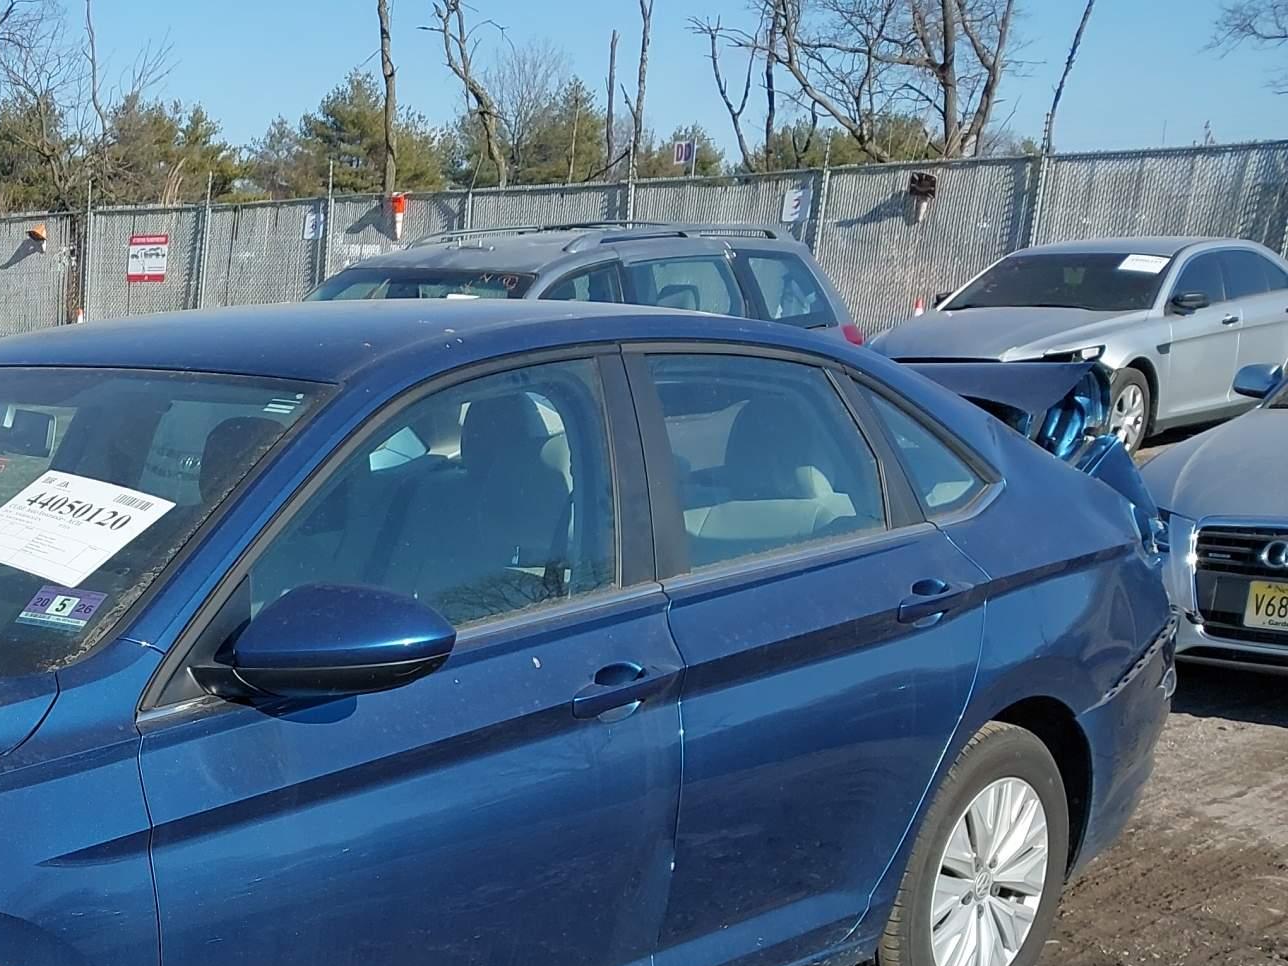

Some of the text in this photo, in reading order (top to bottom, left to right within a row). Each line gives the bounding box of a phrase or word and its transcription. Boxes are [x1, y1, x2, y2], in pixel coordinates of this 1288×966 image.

[26, 492, 132, 531] 44050120
[34, 597, 94, 614] 20 5 26
[1255, 593, 1288, 618] V68
